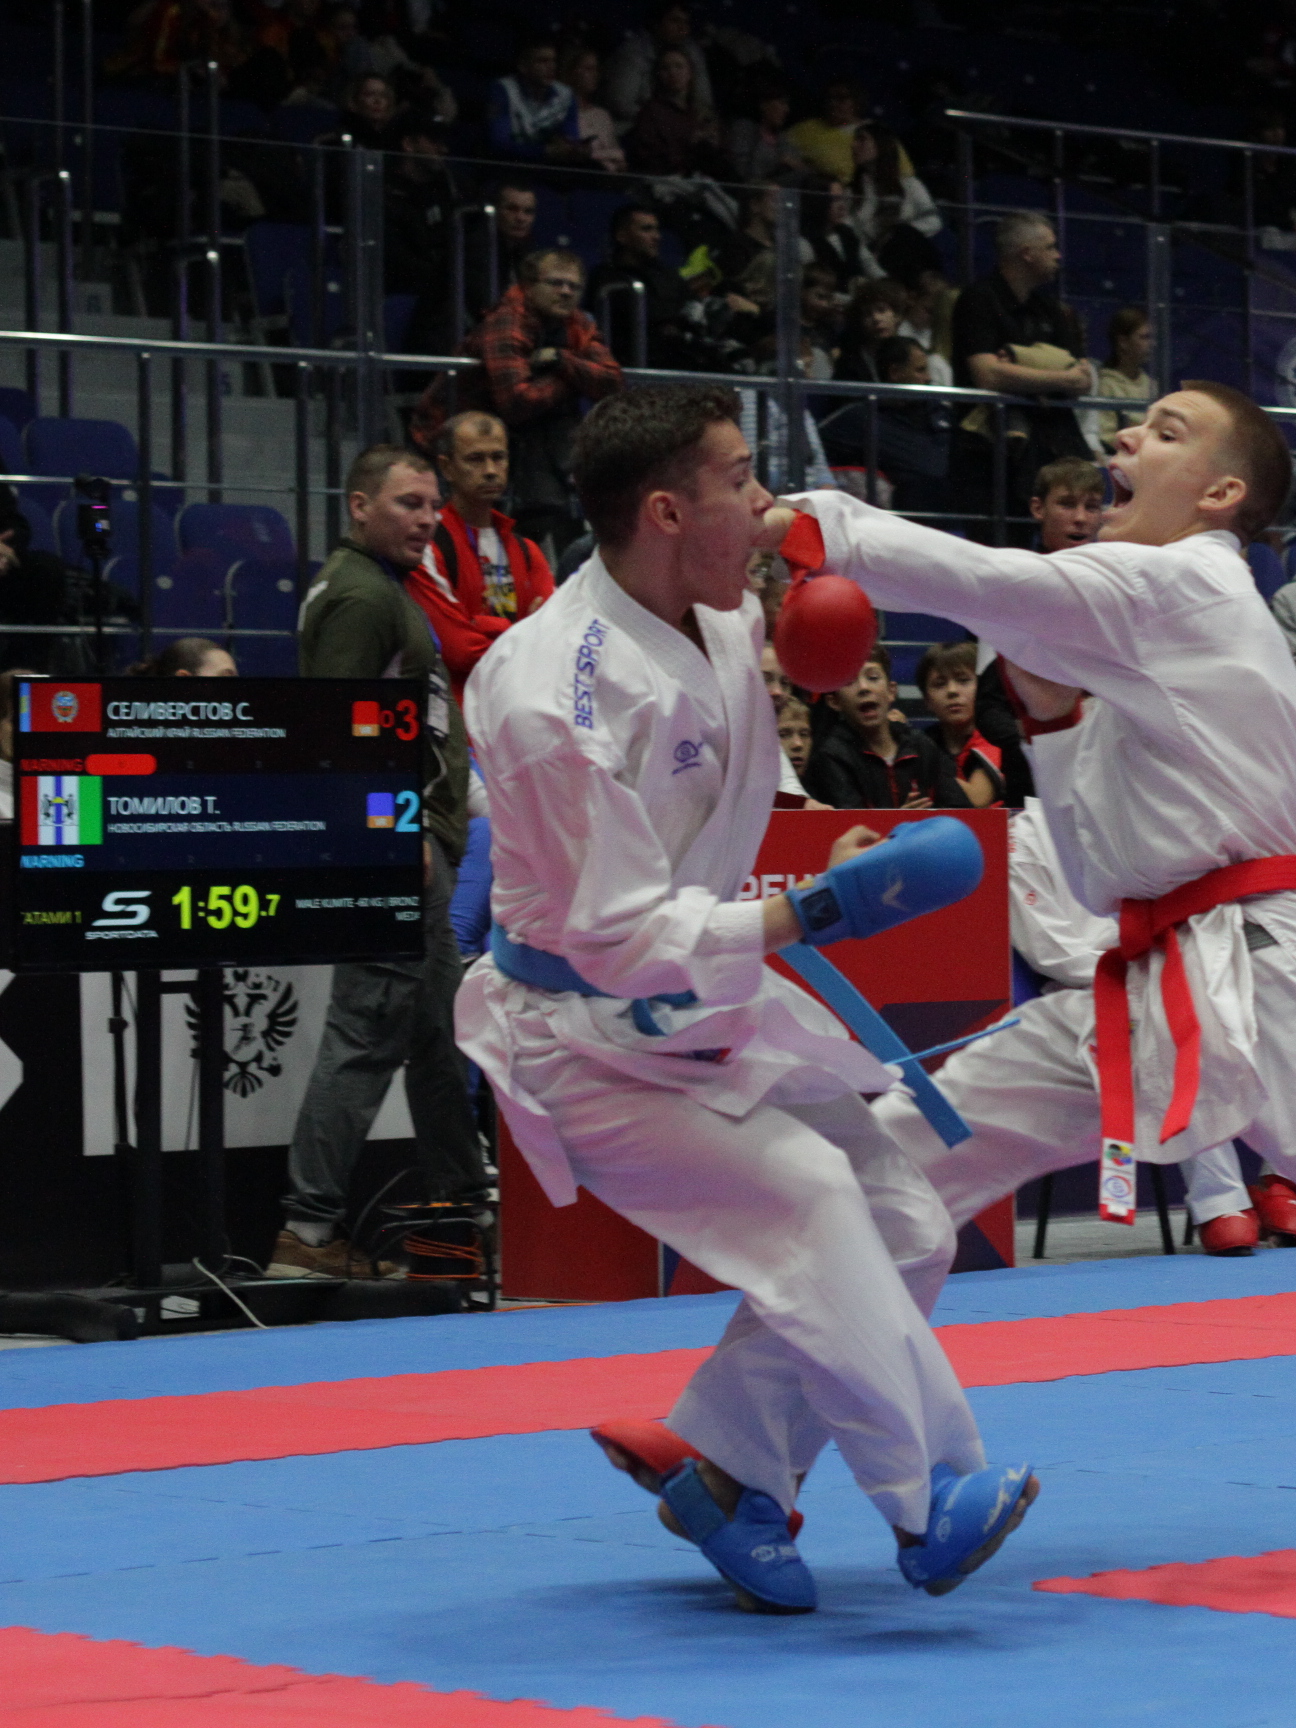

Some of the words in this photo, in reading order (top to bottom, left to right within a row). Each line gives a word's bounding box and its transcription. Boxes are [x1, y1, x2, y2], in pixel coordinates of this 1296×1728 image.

[106, 702, 234, 721] СЕЛИВЕРСТОВ
[395, 699, 420, 741] 3
[107, 797, 202, 815] ТОМИЛОВ
[394, 790, 421, 832] 2
[19, 854, 85, 869] WARNING
[84, 930, 159, 940] SPORTDATA
